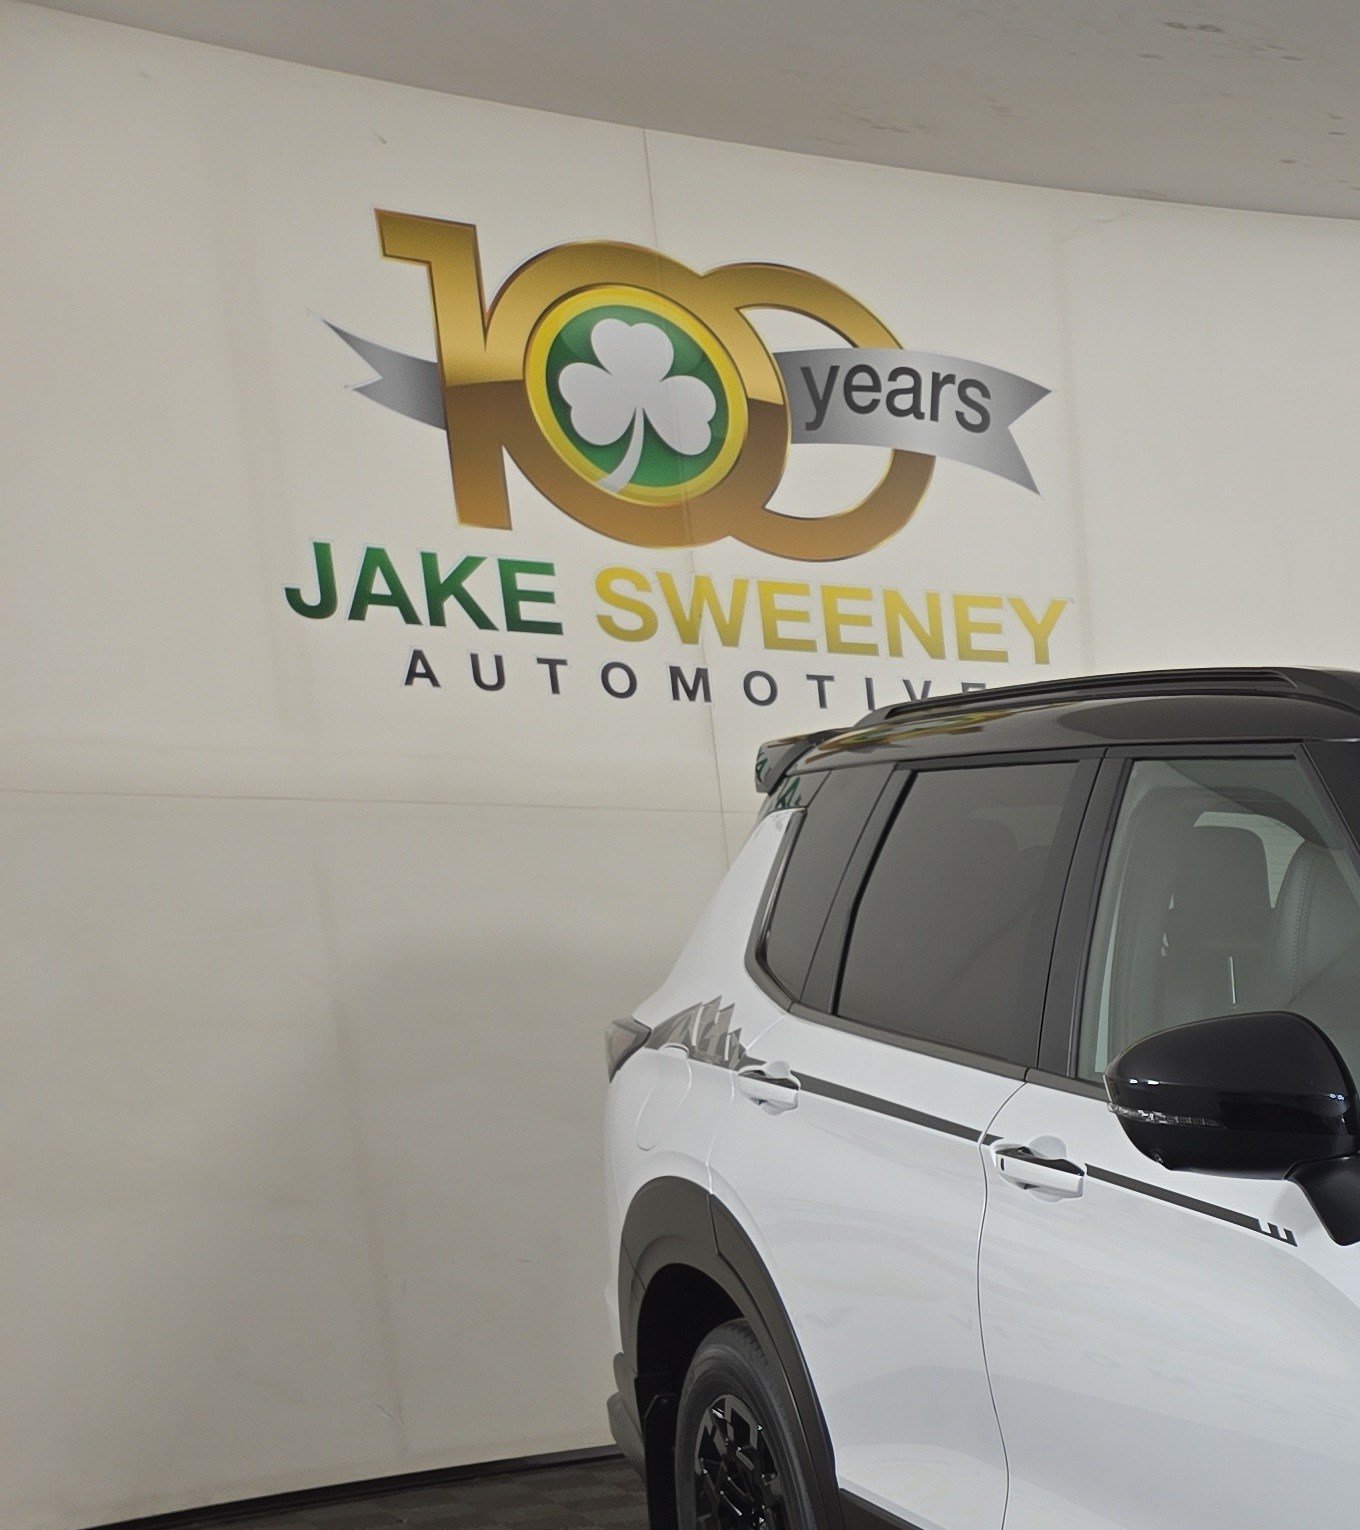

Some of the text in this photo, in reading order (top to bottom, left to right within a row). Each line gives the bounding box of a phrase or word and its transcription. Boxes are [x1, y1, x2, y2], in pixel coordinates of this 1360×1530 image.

[800, 363, 992, 434] years
[284, 541, 1068, 665] JAKE SWEENEY
[404, 649, 988, 711] AUTOMOTIV
